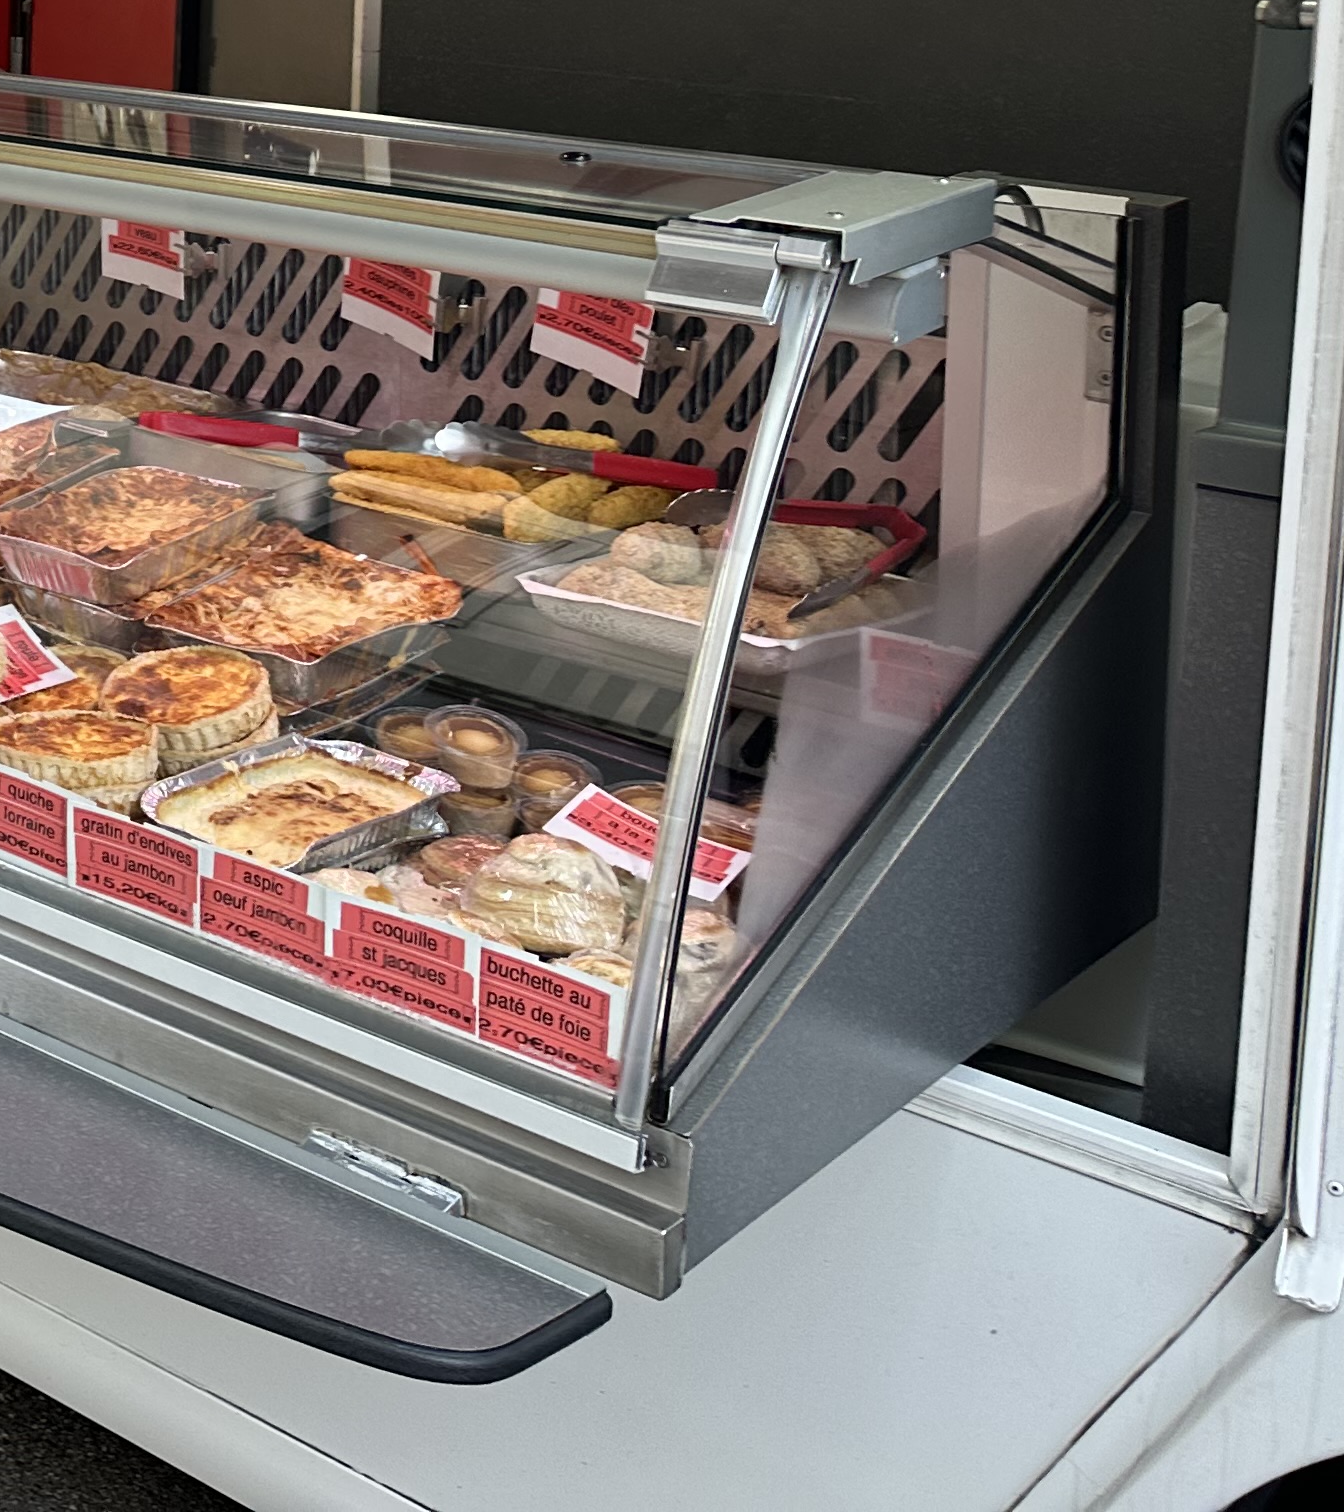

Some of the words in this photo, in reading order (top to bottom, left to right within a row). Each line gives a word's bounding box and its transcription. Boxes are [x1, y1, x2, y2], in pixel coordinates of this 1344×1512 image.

[579, 304, 616, 326] poulet
[7, 784, 54, 812] quiche
[4, 806, 56, 839] lorraine
[81, 817, 123, 840] gratin
[127, 829, 193, 868] d'endives
[101, 850, 120, 866] au
[123, 854, 176, 888] jambon
[243, 871, 284, 896] aspic
[213, 889, 248, 911] oeuf
[249, 901, 306, 936] jambon
[372, 919, 437, 952] coquille
[362, 944, 377, 962] st
[380, 948, 447, 986] jacques
[487, 955, 564, 1000] buchette
[569, 988, 592, 1010] au
[486, 991, 526, 1017] paté
[531, 1005, 554, 1026] de
[559, 1016, 592, 1042] foie
